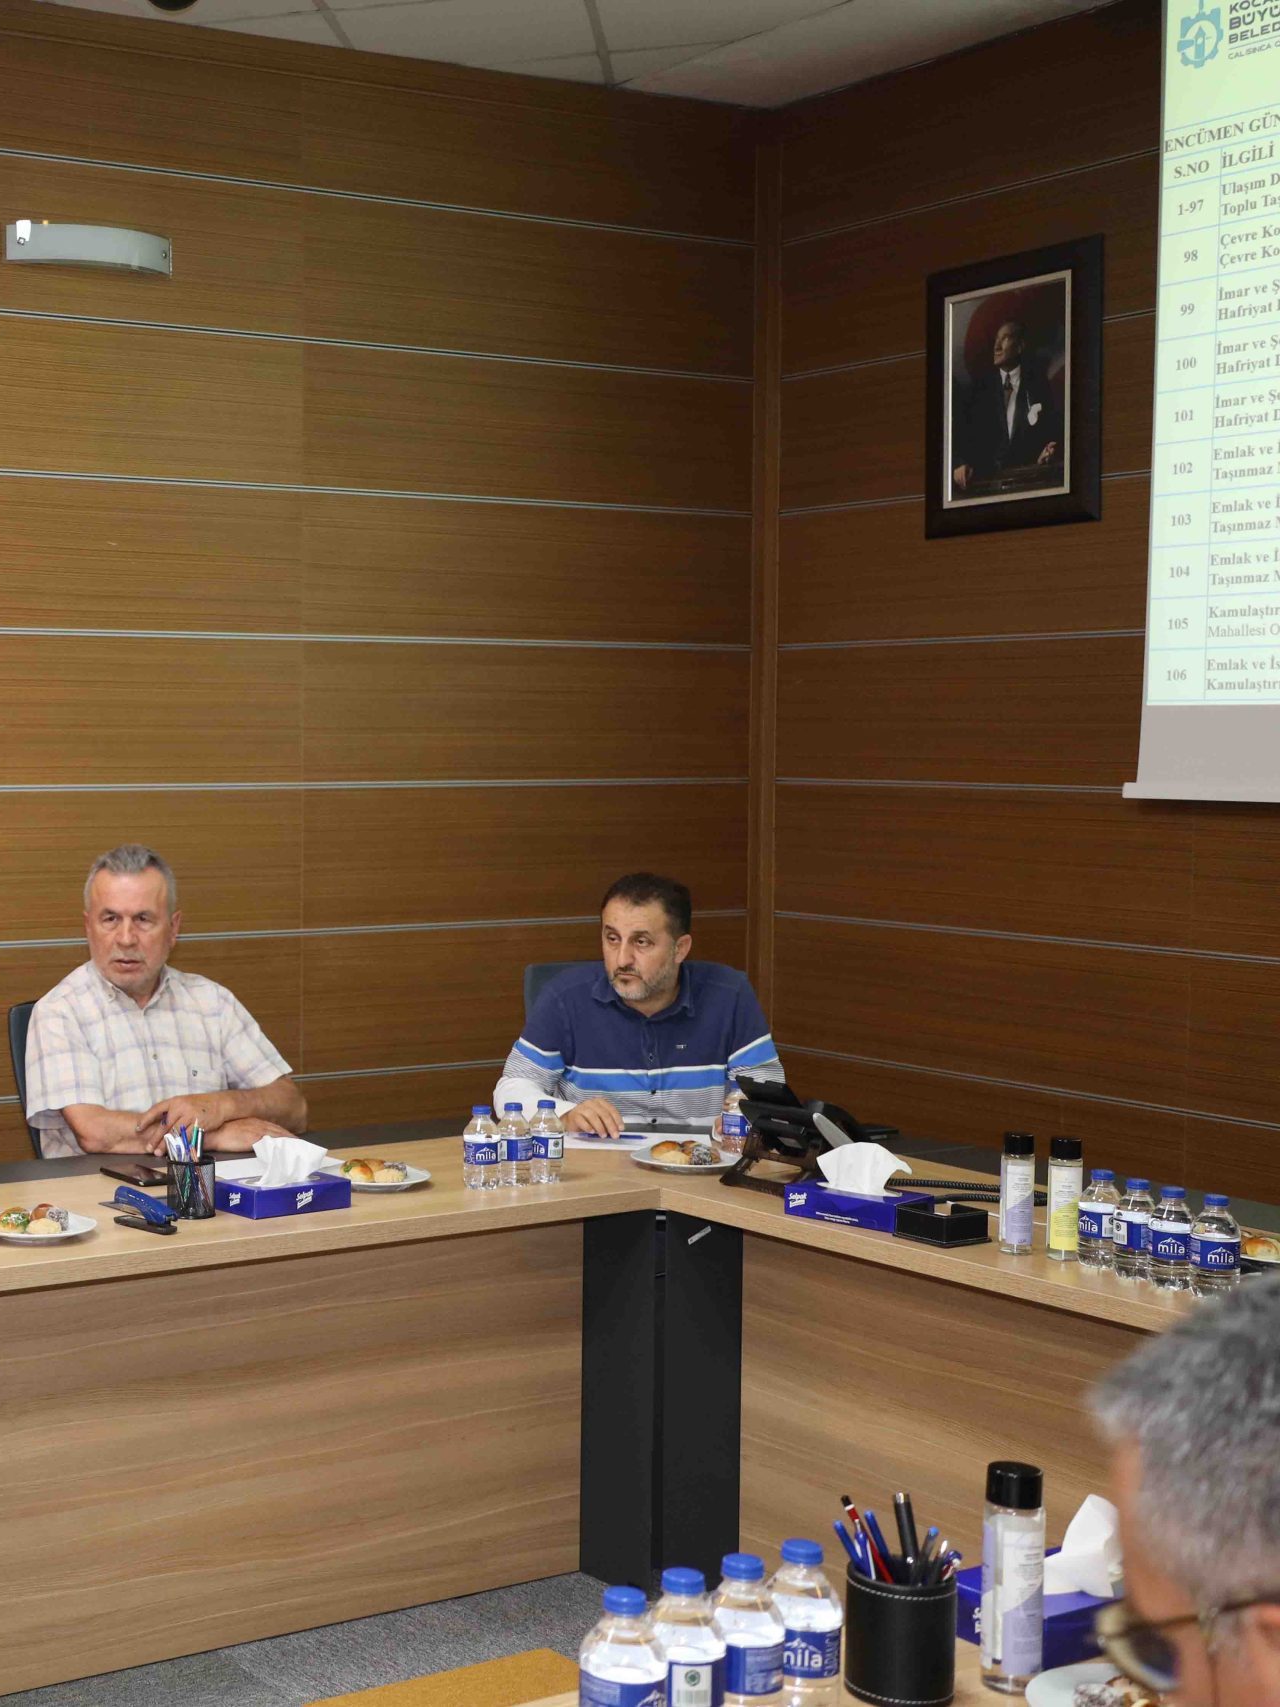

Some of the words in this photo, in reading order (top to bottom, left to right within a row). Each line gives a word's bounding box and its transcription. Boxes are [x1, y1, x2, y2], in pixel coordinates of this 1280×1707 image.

[1164, 122, 1244, 153] ENCÜMEN
[1174, 160, 1209, 179] S.NO
[1222, 140, 1274, 168] İLGİLİ
[1222, 179, 1266, 195] Ulaşım
[1178, 199, 1204, 216] 1-97
[1221, 199, 1257, 216] Toplu
[1220, 231, 1258, 249] Çevre
[1184, 249, 1199, 263] 98
[1219, 251, 1257, 269] Çevre
[1253, 284, 1268, 294] ve
[1180, 303, 1195, 316] 99
[1218, 301, 1272, 321] Hafriyat
[1252, 339, 1266, 349] ve
[1176, 357, 1197, 371] 100
[1216, 357, 1270, 375] Hafriyat
[1251, 394, 1265, 404] ve
[1174, 409, 1194, 423] 101
[1214, 411, 1269, 428] Hafriyat
[1213, 445, 1255, 460] Emlak
[1259, 446, 1273, 455] ve
[1173, 462, 1193, 475] 102
[1213, 465, 1273, 481] Taşınmaz
[1212, 499, 1253, 513] Emlak
[1257, 499, 1271, 509] ve
[1171, 514, 1192, 527] 103
[1211, 520, 1271, 535] Taşınmaz
[1210, 552, 1251, 566] Emlak
[1256, 553, 1270, 563] ve
[1170, 565, 1190, 578] 104
[1209, 573, 1270, 588] Taşınmaz
[1168, 617, 1189, 630] 105
[1208, 623, 1265, 638] Mahallesi
[1207, 658, 1248, 671] Emlak
[1252, 660, 1266, 670] ve
[1167, 669, 1187, 682] 106
[475, 1152, 497, 1161] mila
[788, 1192, 807, 1202] Selpak
[1158, 1243, 1185, 1254] mila
[1207, 1253, 1234, 1264] mila
